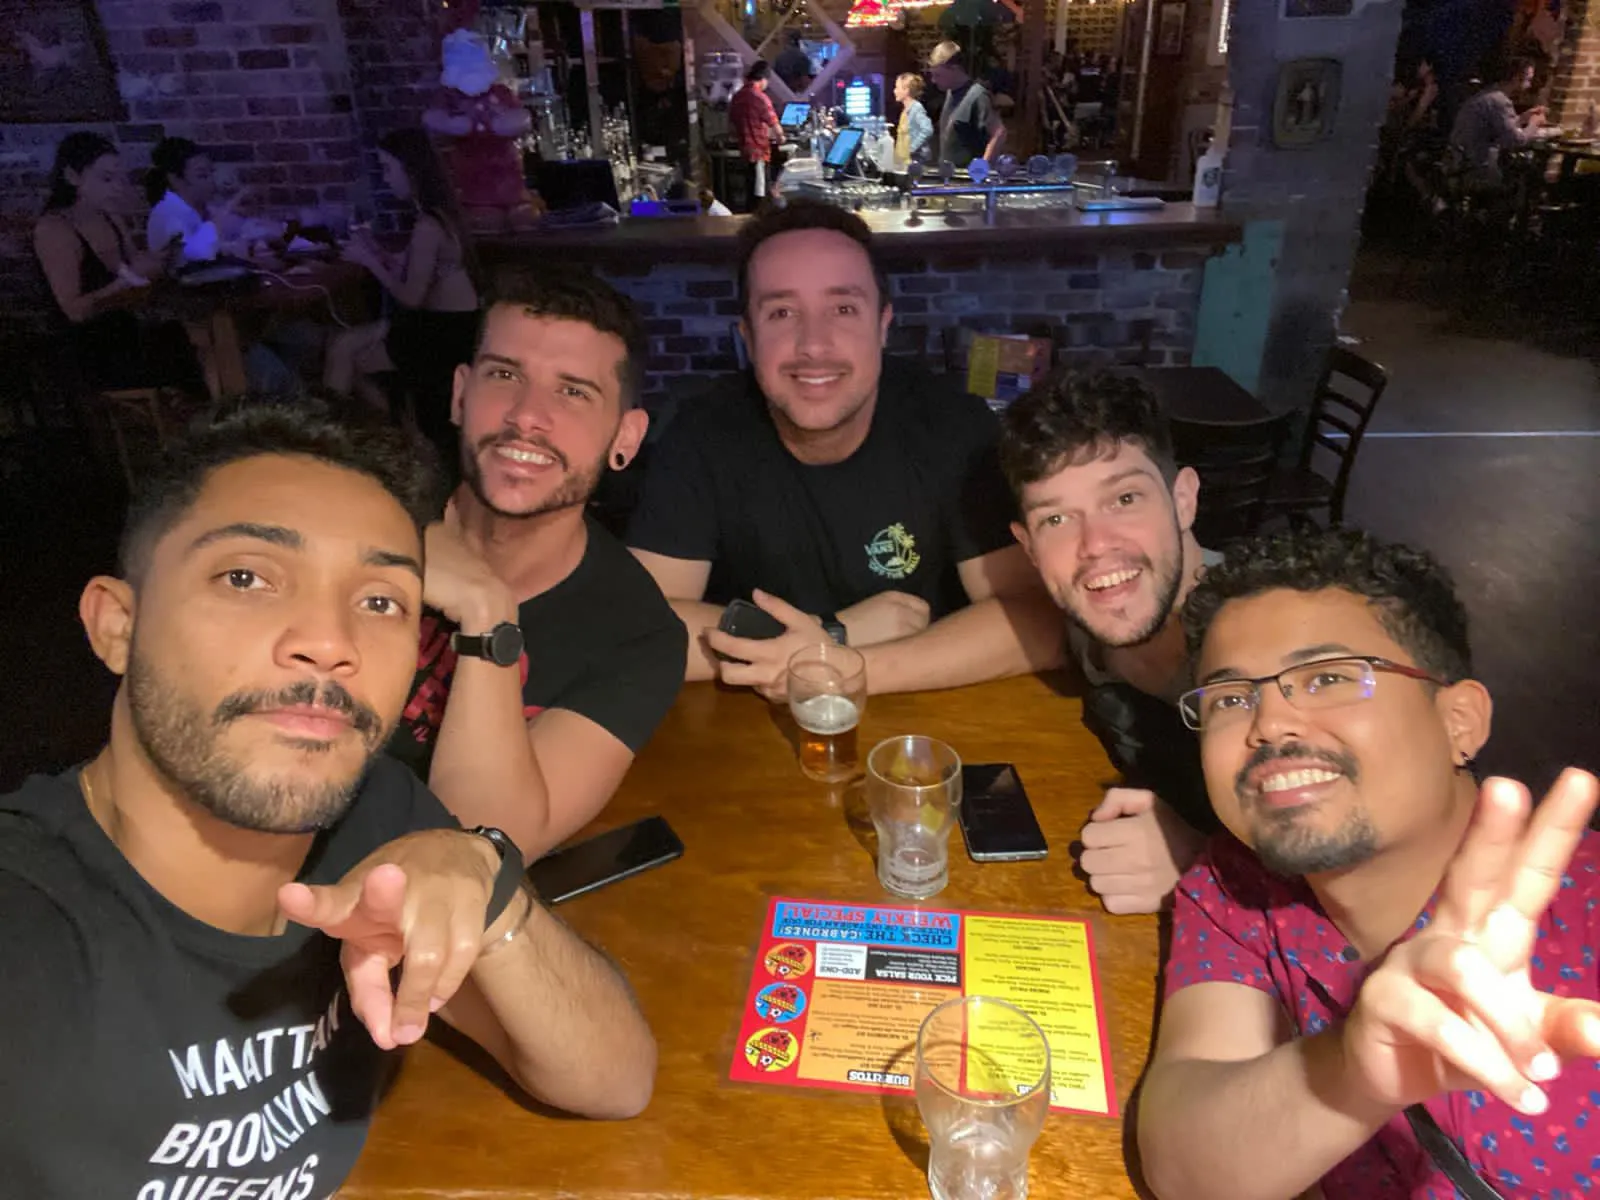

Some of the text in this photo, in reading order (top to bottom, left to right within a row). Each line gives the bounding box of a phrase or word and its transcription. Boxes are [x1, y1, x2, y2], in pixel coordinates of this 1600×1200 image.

[783, 905, 865, 921] SPECIAL!
[873, 912, 953, 928] WEEKLY
[863, 929, 896, 942] THE
[902, 931, 953, 945] CHECK
[875, 968, 957, 983] PICK YOUR SALSA
[848, 1069, 911, 1087] BURRITOS
